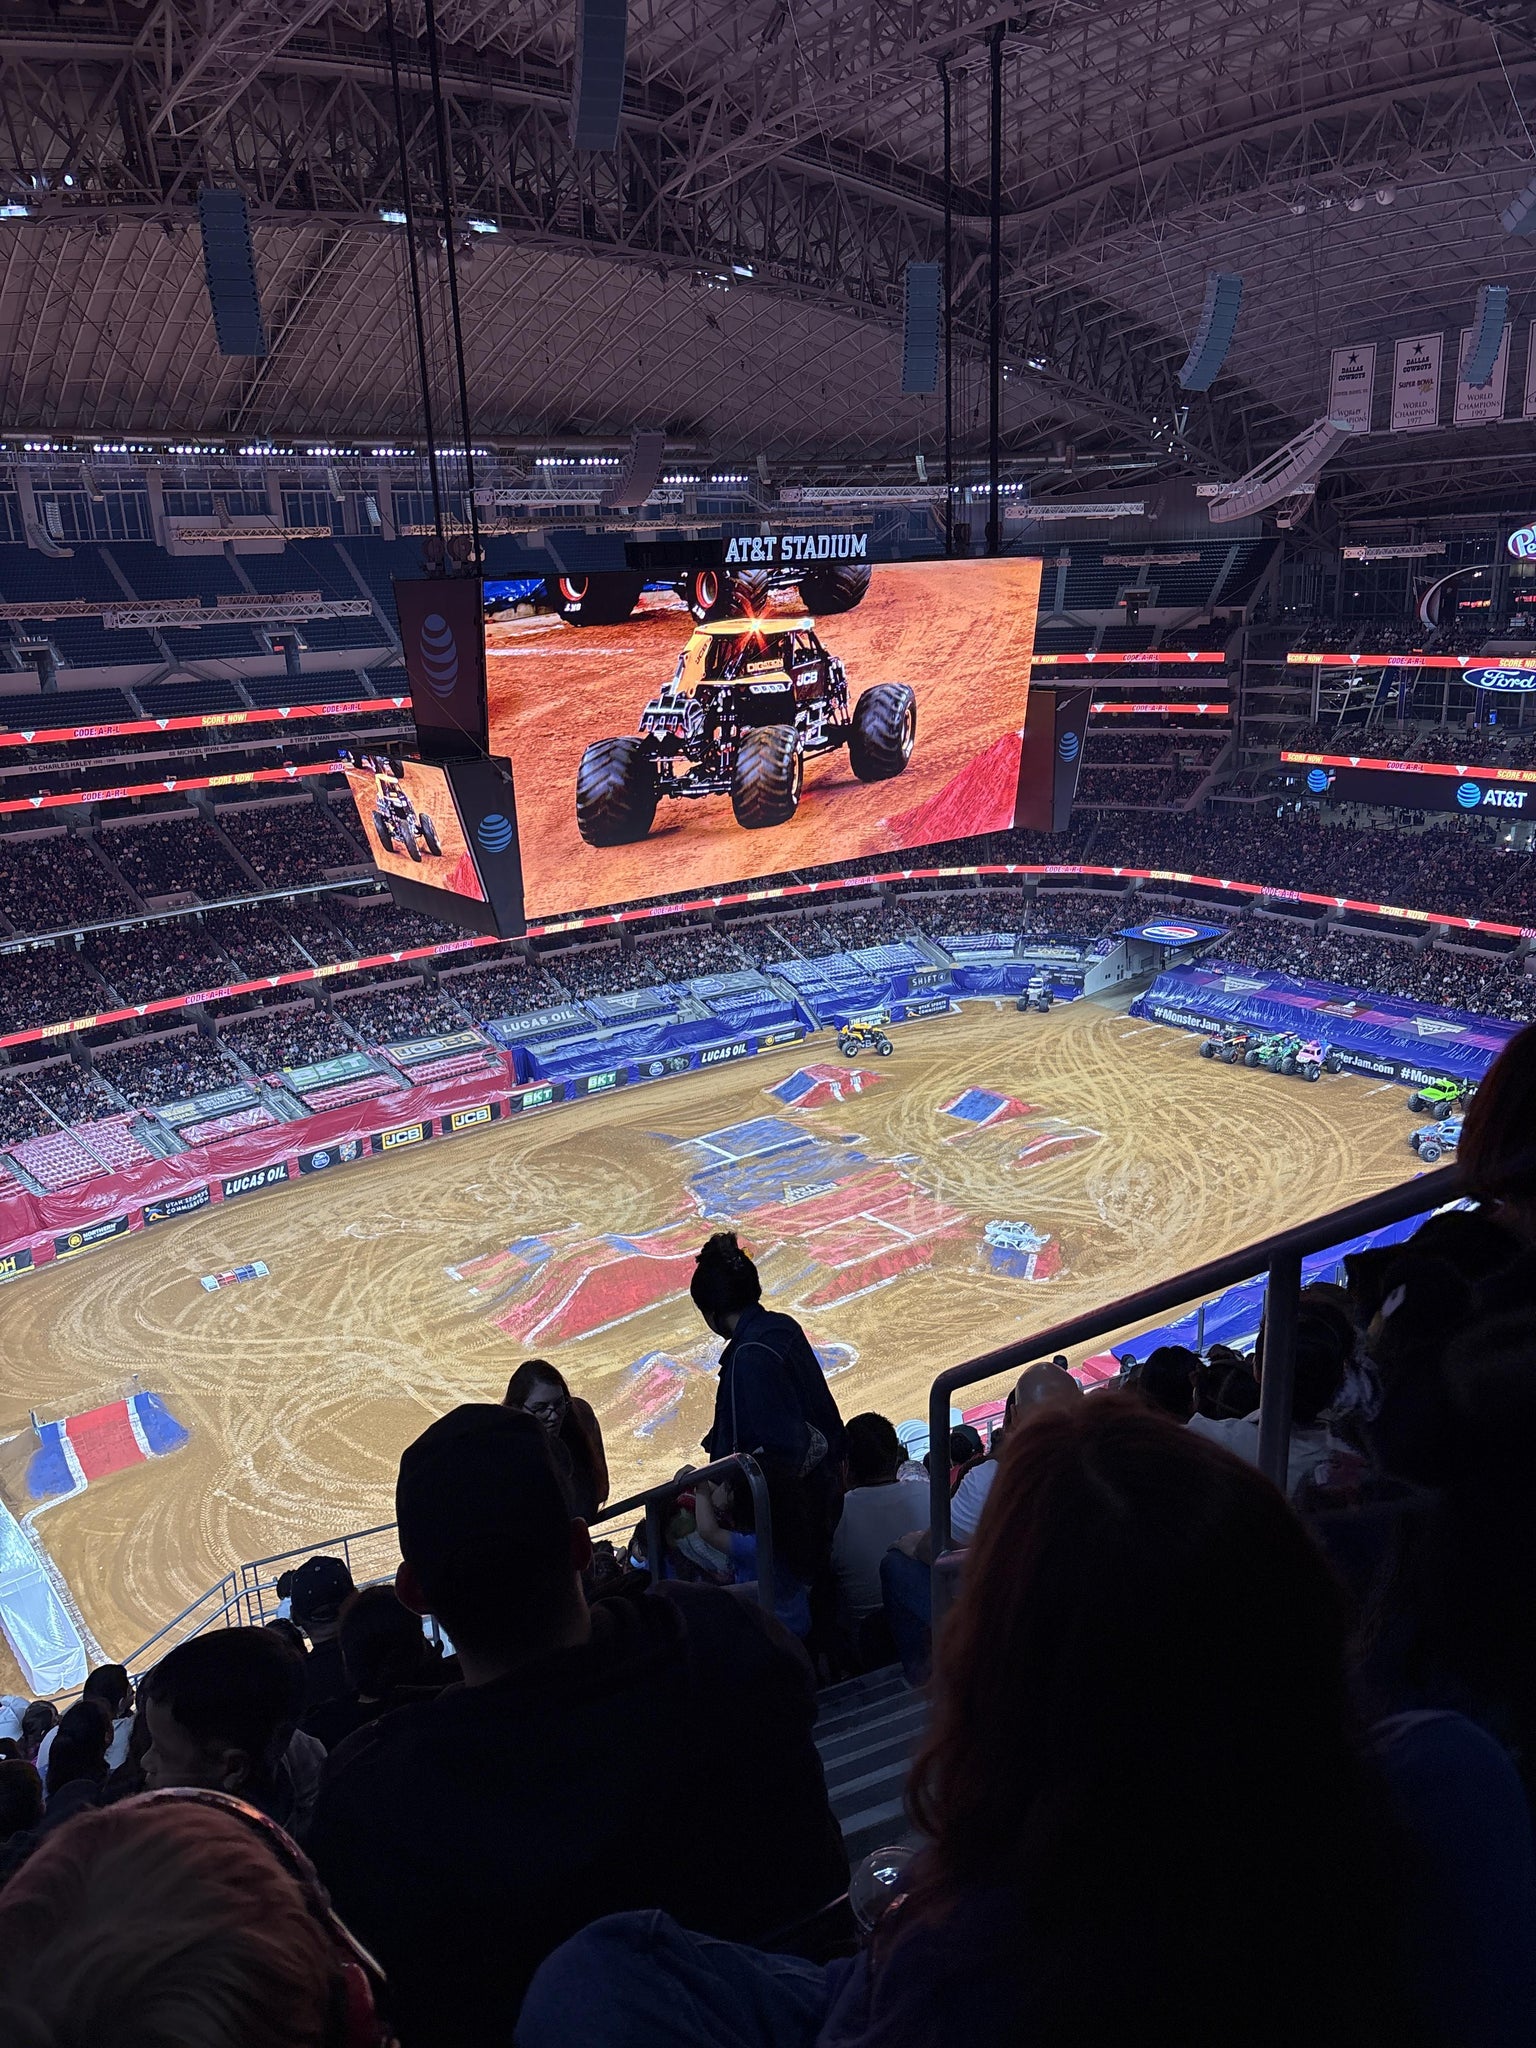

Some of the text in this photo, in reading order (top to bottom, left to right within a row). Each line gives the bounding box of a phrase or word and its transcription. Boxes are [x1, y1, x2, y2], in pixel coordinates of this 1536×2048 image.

[1466, 392, 1494, 401] WORLD
[1402, 400, 1428, 410] WORLD
[1458, 400, 1500, 410] CHAMPIONS
[1394, 408, 1435, 418] CHAMPIONS
[1470, 409, 1487, 417] 1992
[1407, 416, 1422, 424] 1977
[725, 534, 868, 562] AT&T STADIUM
[1406, 657, 1426, 665] A-R-L
[1498, 658, 1523, 668] SCORE
[796, 672, 818, 686] JCB
[1480, 669, 1536, 689] Ford
[202, 714, 247, 725] SCORE NOW!
[74, 726, 120, 738] CODE: A-R-L
[38, 762, 70, 772] CHARLES
[70, 760, 92, 768] HALEY
[1386, 762, 1425, 771] CODE: A-R-L
[208, 774, 254, 787] SCORE NOW!
[1496, 770, 1522, 780] SCORE
[81, 789, 128, 802] CODE: A-R-L
[1482, 789, 1528, 809] AT&T
[312, 962, 359, 978] SCORE NOW!
[912, 974, 938, 987] SHIFT
[210, 988, 231, 998] A-R-L
[502, 1010, 575, 1034] LUCAS OIL
[1154, 1006, 1222, 1032] #MonsterJam
[42, 1017, 96, 1038] SCORE NOW!
[701, 1043, 747, 1064] LUCAS OIL
[290, 1054, 365, 1083] BKT
[1332, 1051, 1395, 1076] terJam.com
[588, 1073, 617, 1088] BKT
[522, 1087, 553, 1106] BKT
[455, 1108, 489, 1127] JCB
[386, 1126, 420, 1146] JCB
[225, 1165, 288, 1196] LUCAS OIL
[166, 1196, 209, 1215] COMMISSION
